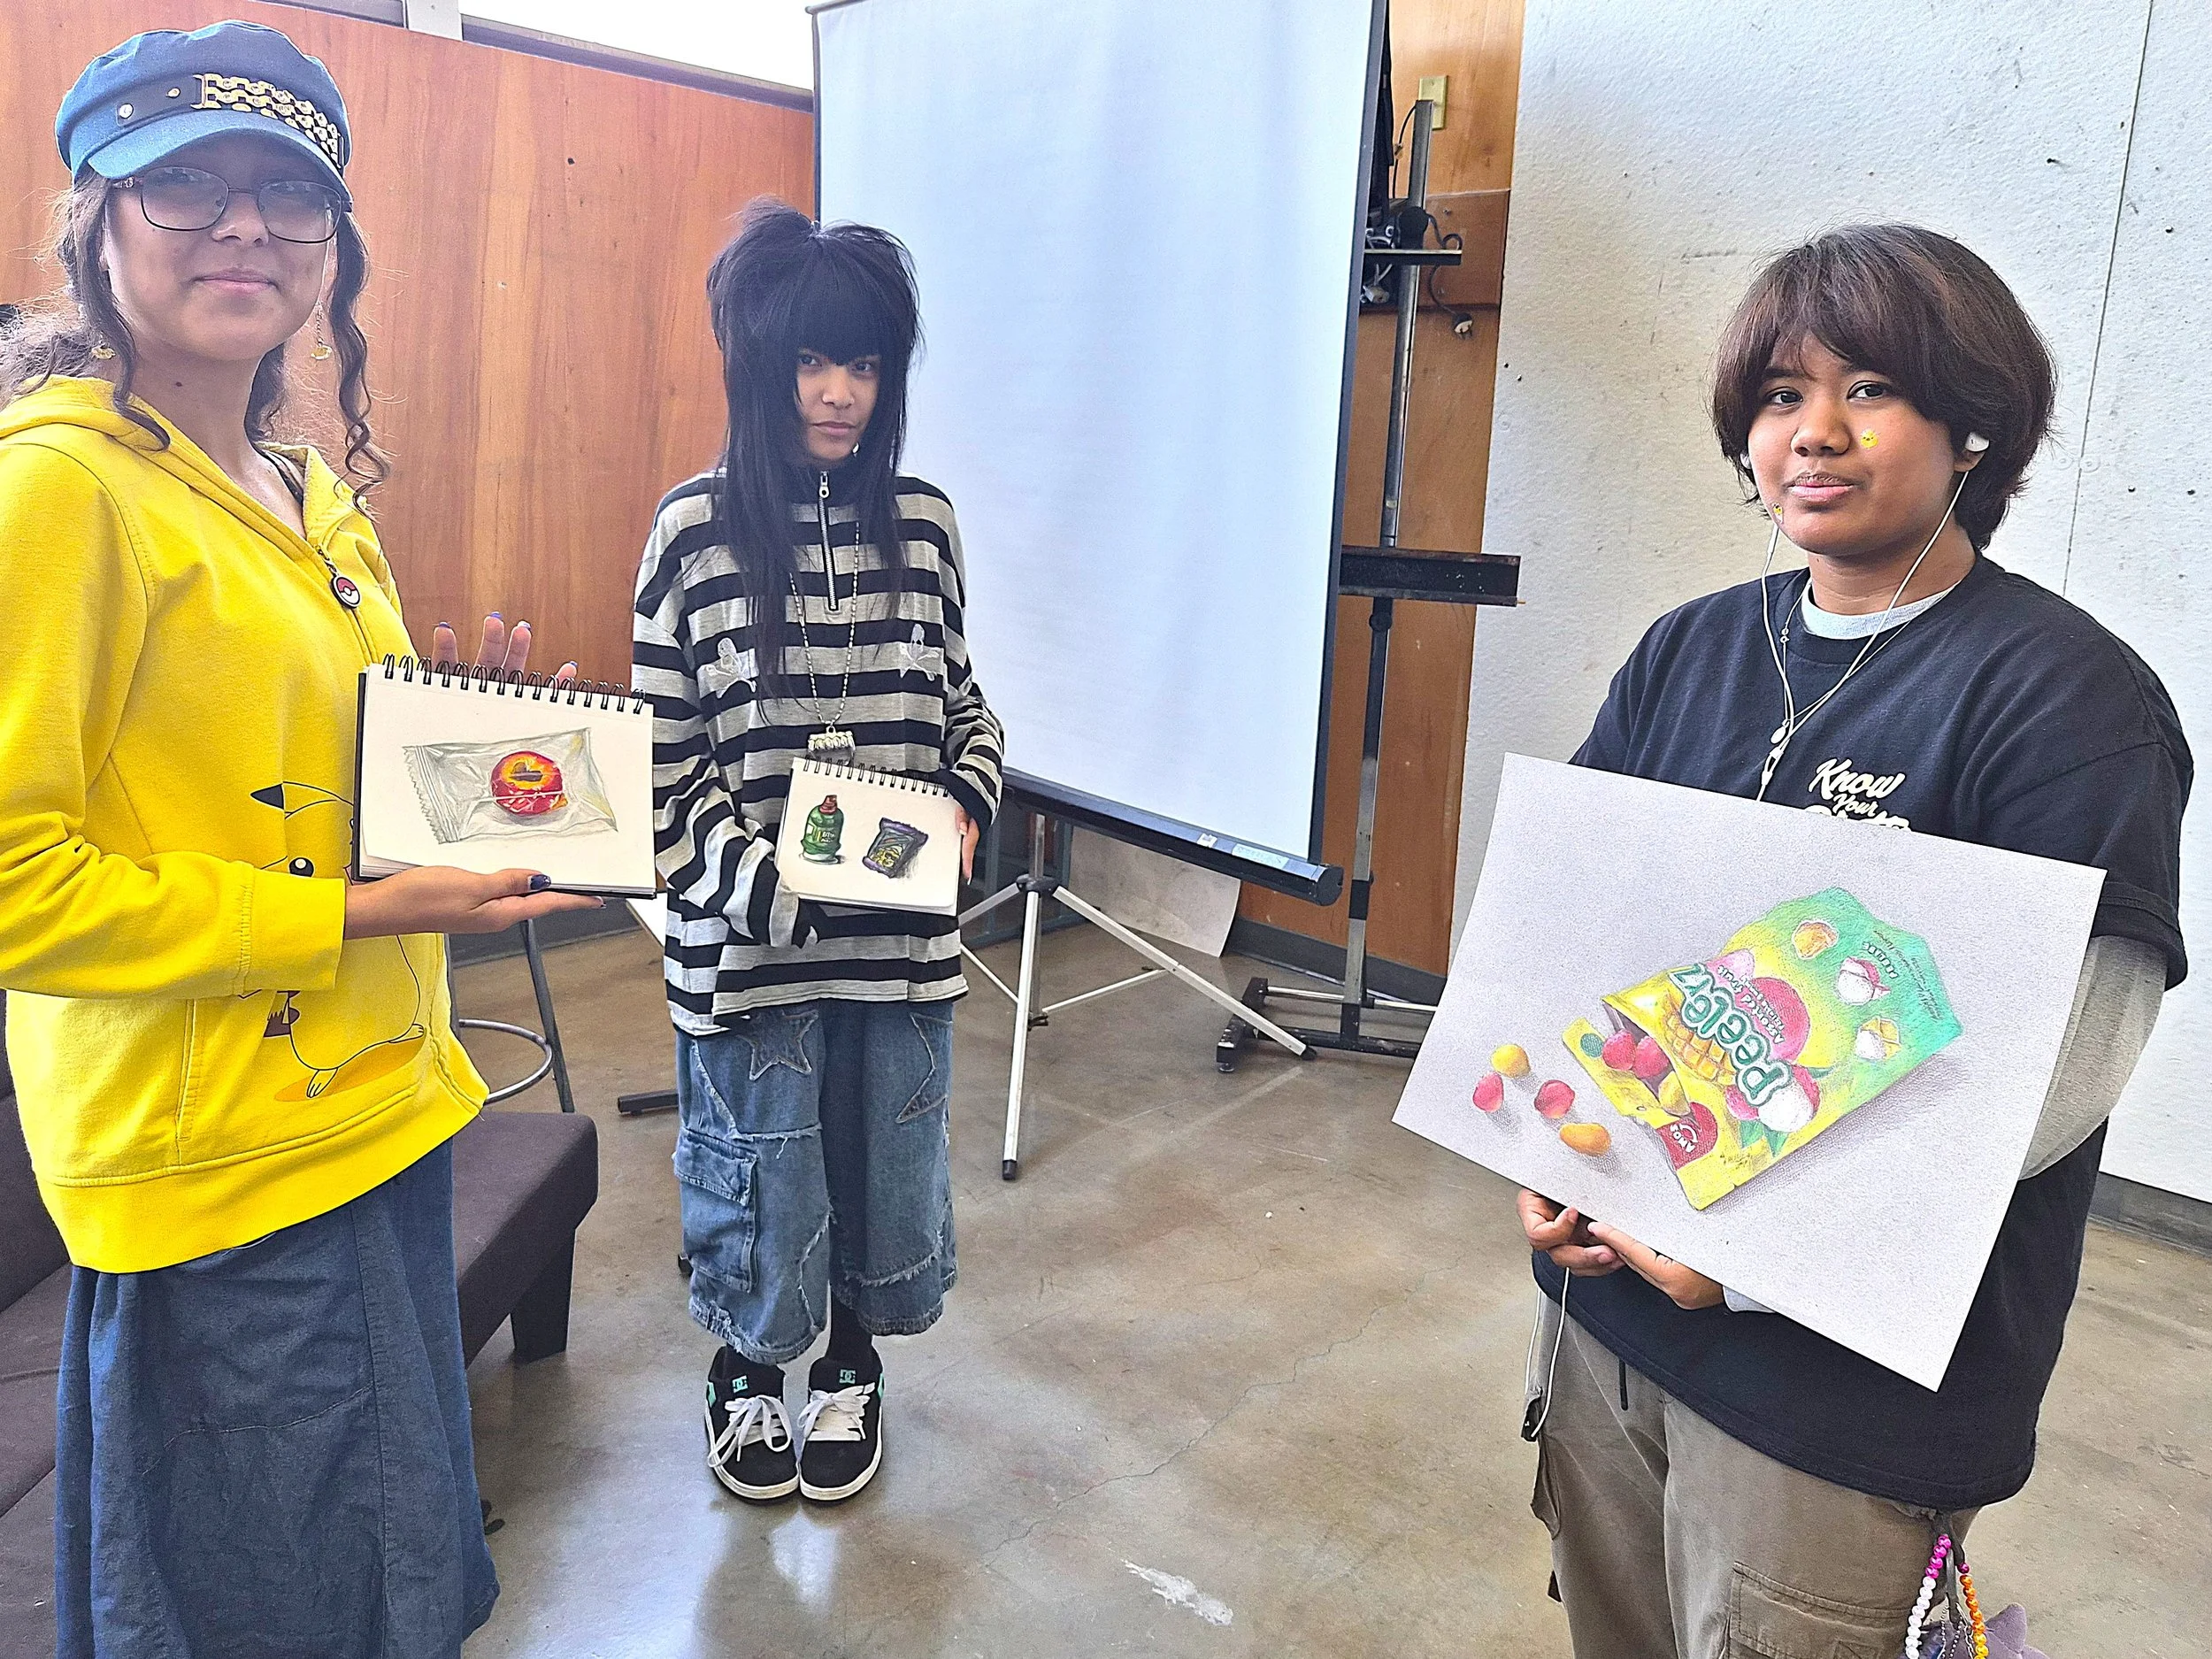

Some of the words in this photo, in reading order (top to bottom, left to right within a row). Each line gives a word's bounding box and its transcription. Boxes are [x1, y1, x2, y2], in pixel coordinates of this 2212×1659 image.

[1808, 758, 1906, 800] Know
[1832, 793, 1878, 817] Your
[1717, 964, 1744, 995] fruit
[1741, 994, 1786, 1044] Assorted
[1670, 1124, 1696, 1153] AMOS
